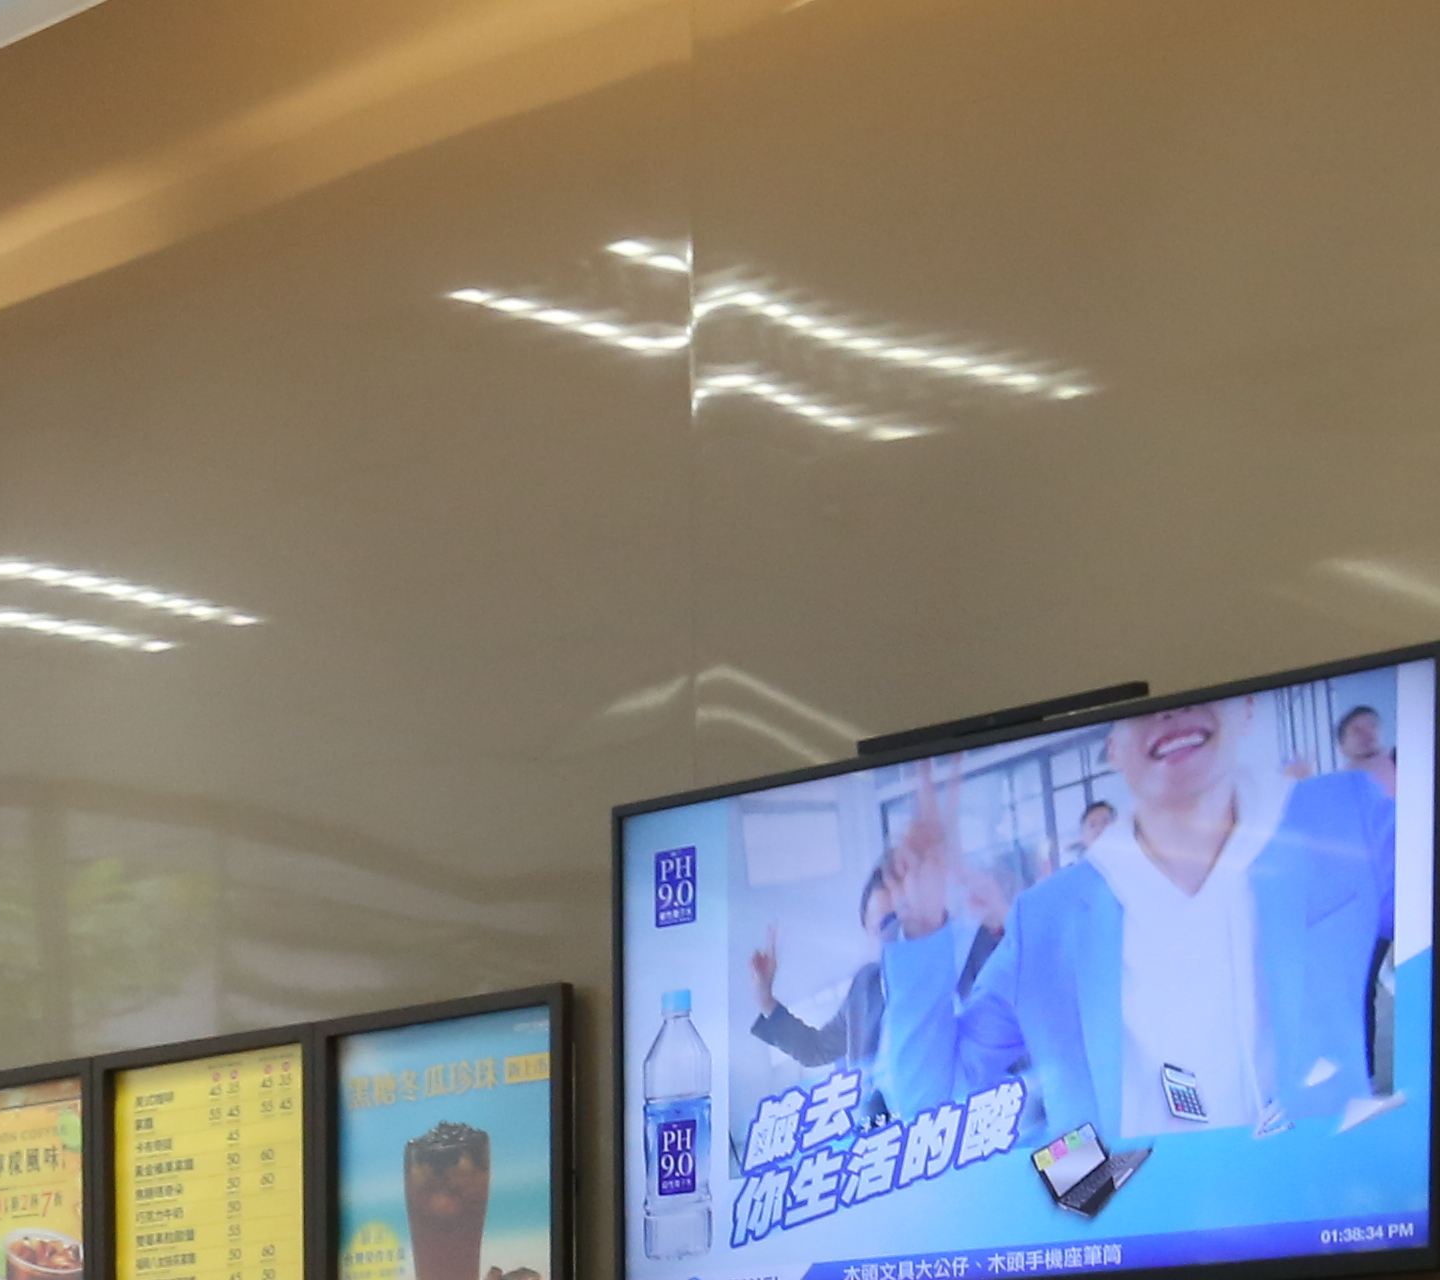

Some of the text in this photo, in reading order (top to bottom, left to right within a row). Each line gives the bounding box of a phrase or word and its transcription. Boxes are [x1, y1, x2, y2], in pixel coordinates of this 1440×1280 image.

[660, 857, 691, 880] PH
[657, 881, 694, 910] 9.0
[349, 1057, 498, 1110] 黑糖冬瓜珍珠
[662, 1129, 692, 1152] PH
[660, 1152, 694, 1179] 9.0
[730, 1077, 1027, 1248] 你生活的酸
[1320, 1221, 1414, 1244] 01:38:34 PM
